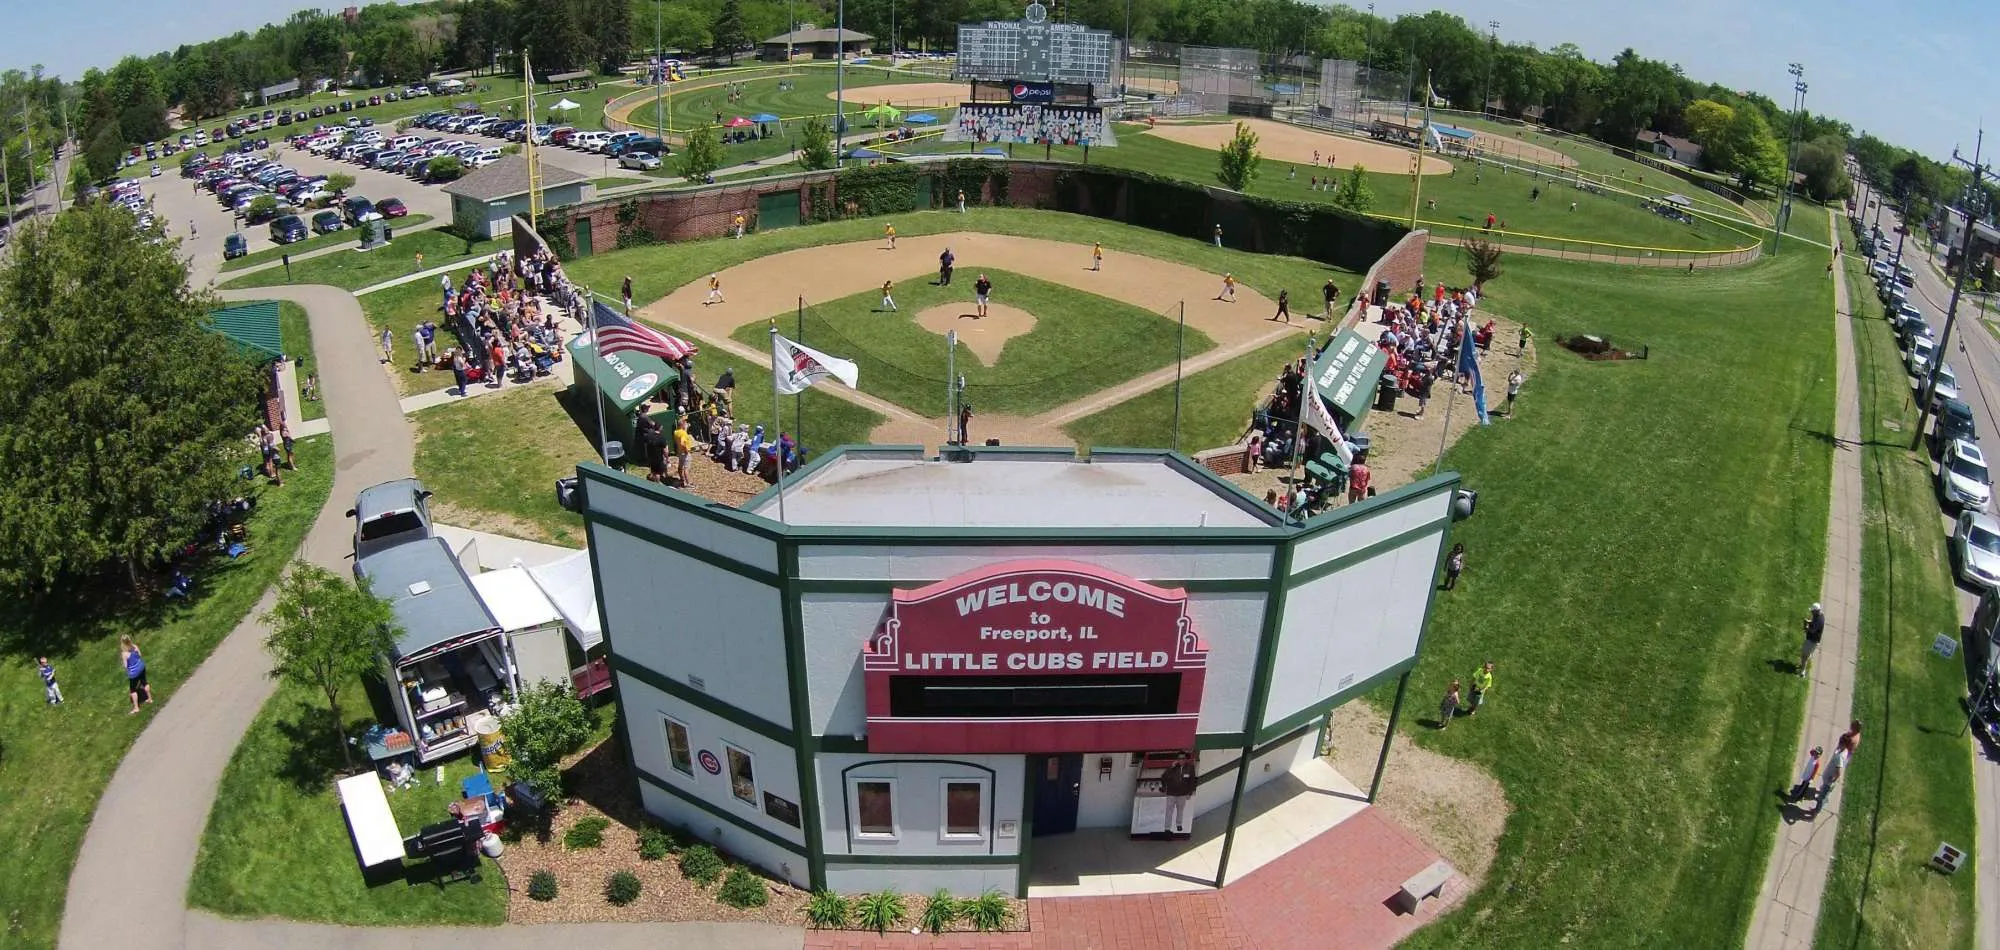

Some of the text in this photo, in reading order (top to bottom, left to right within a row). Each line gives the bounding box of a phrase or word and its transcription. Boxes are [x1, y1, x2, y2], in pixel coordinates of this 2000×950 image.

[988, 22, 1020, 30] NATIONAL
[1050, 24, 1085, 32] AMERICAN
[614, 362, 633, 378] CUBS
[956, 581, 1126, 618] WELCOME
[1030, 611, 1050, 625] to
[980, 627, 1098, 642] Freeport, IL
[905, 651, 1169, 670] LITTLE CUBS FIELD
